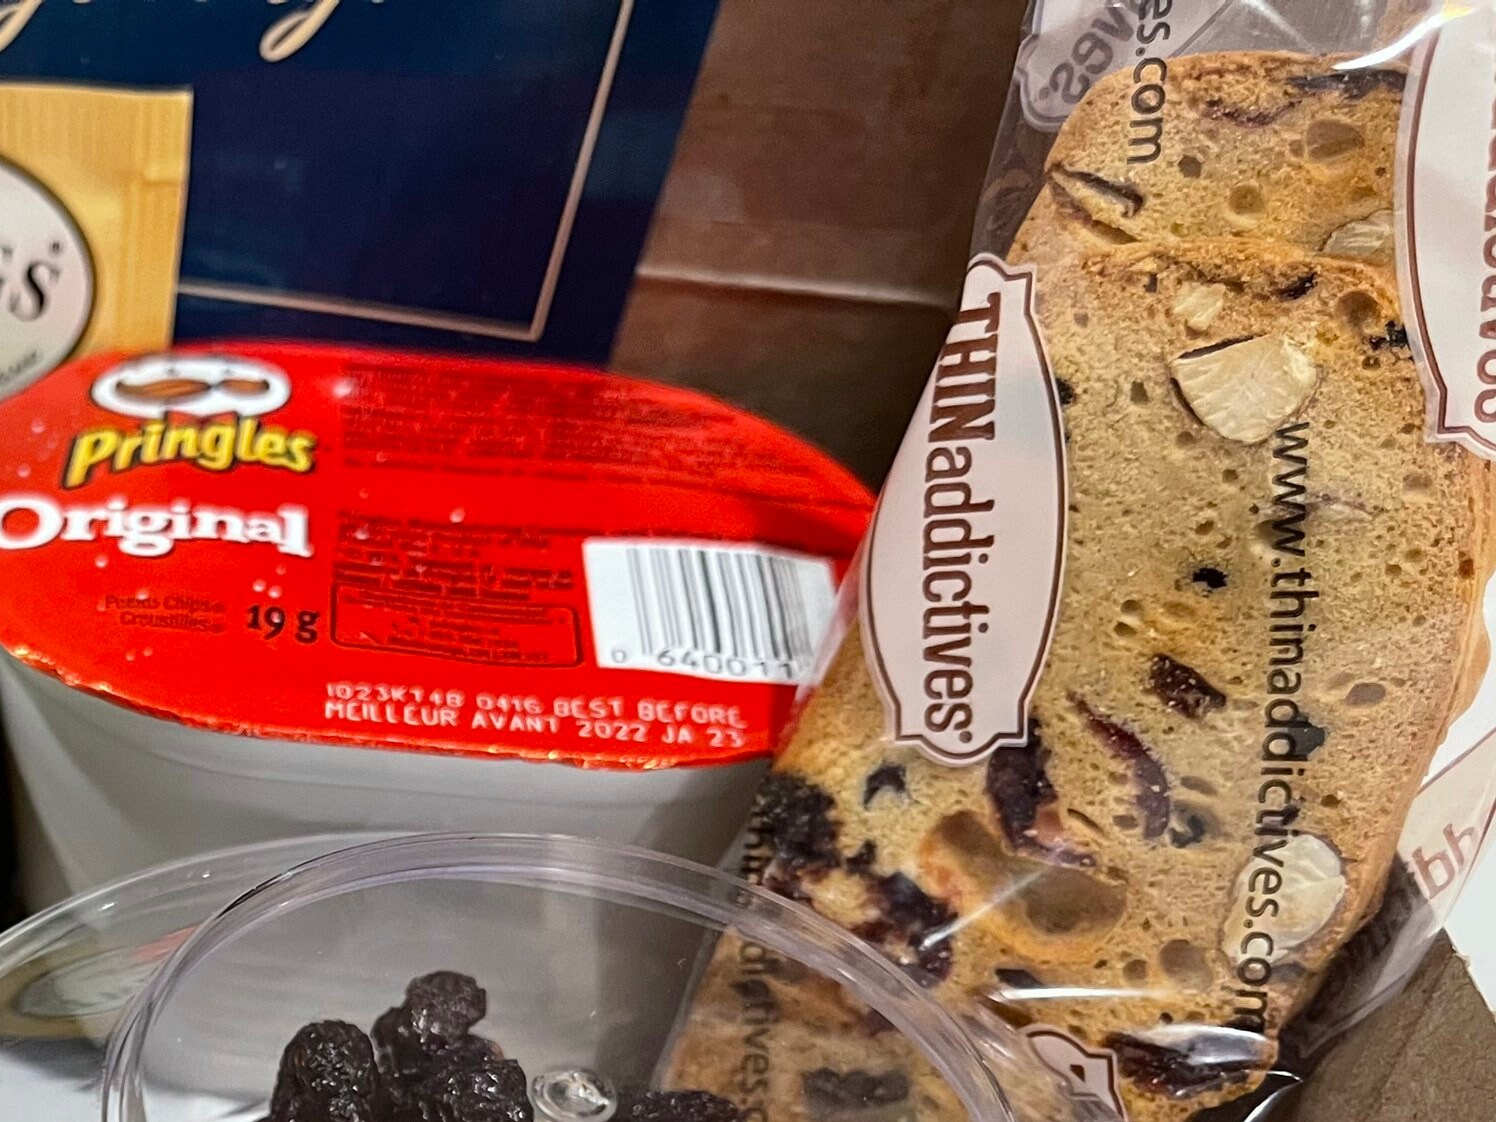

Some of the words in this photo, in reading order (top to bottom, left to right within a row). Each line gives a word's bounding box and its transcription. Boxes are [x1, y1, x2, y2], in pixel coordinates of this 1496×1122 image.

[62, 412, 317, 490] Pringles
[922, 291, 1001, 735] THINaddictives
[247, 604, 287, 641] 19
[295, 609, 320, 644] g
[610, 648, 628, 664] 0
[325, 701, 461, 727] MEILLEUR
[471, 709, 560, 733] AVANT
[575, 719, 651, 742] 2022
[661, 724, 696, 744] JA
[706, 726, 749, 748] 23
[553, 697, 625, 719] BEST
[636, 697, 748, 729] BEFORE
[1234, 421, 1320, 1037] www.thinaddictives.com
